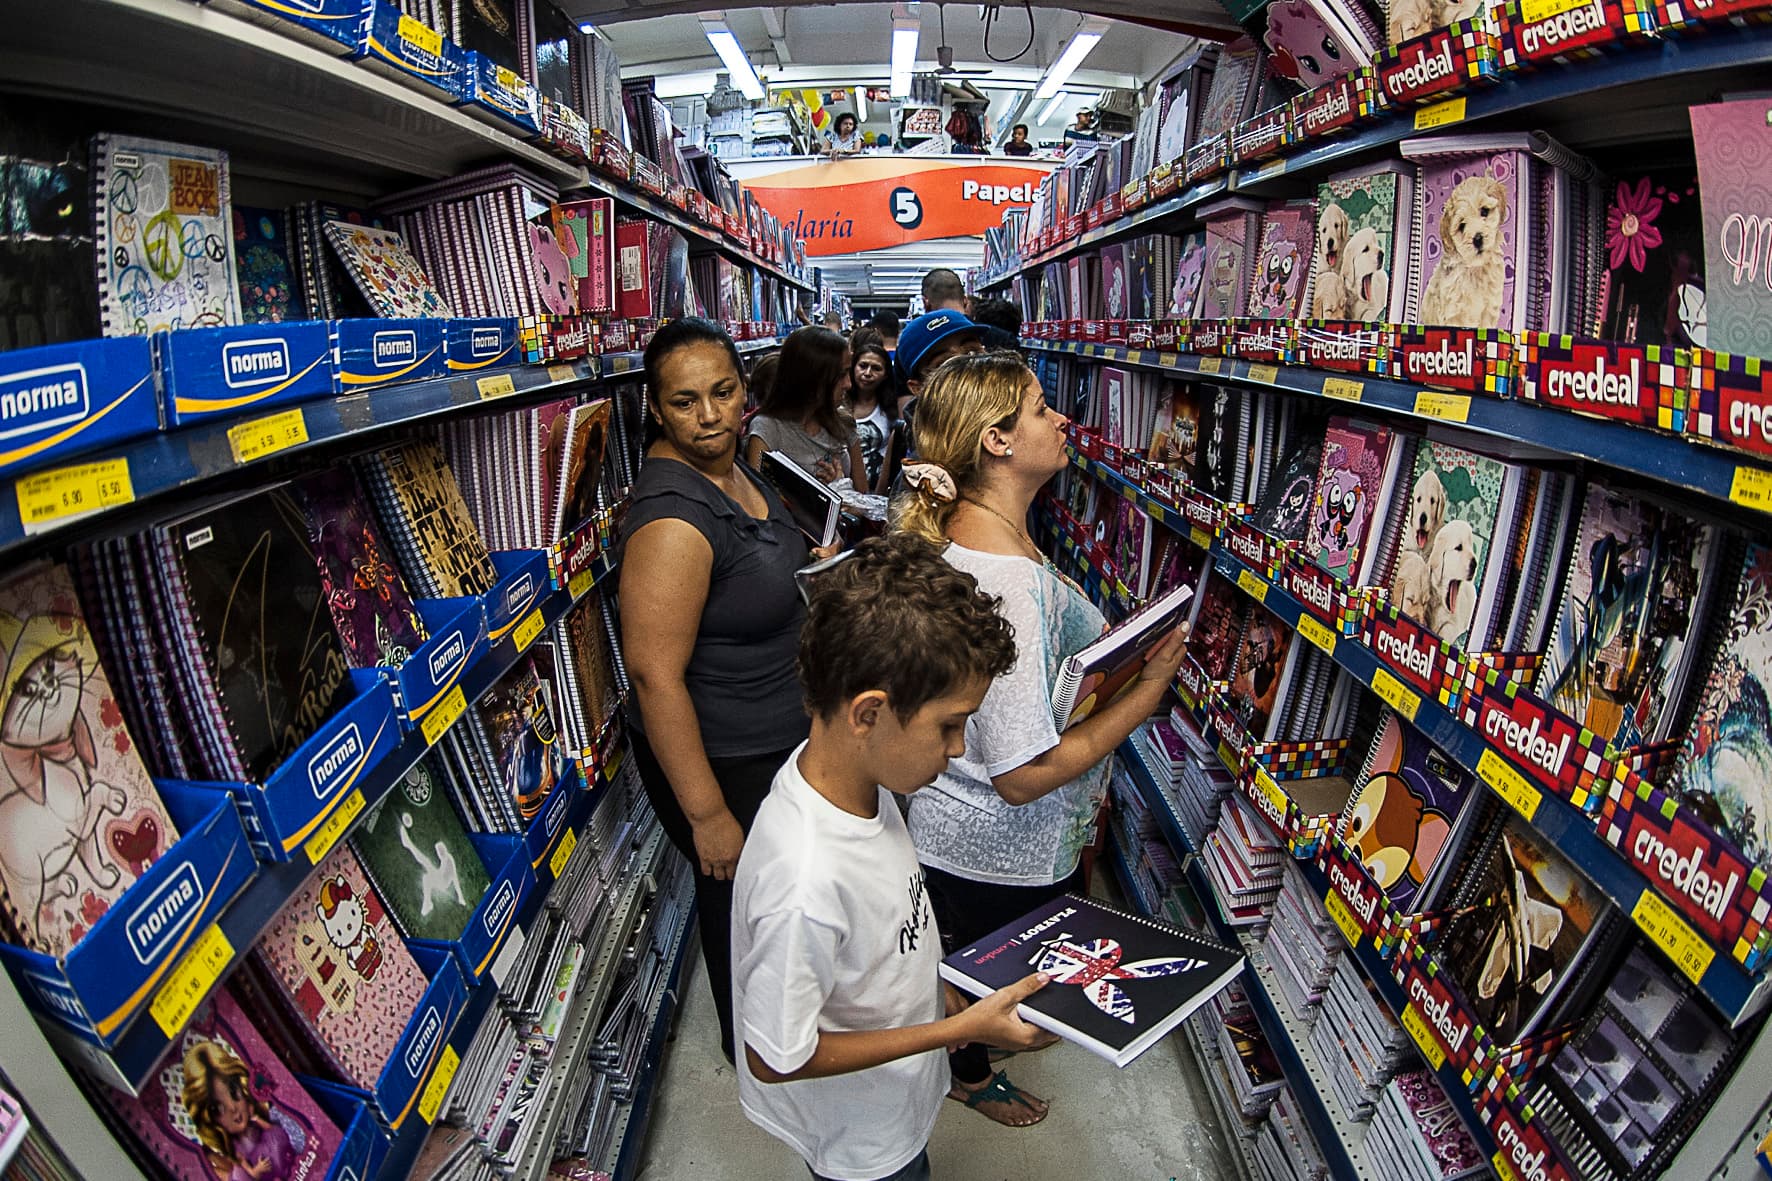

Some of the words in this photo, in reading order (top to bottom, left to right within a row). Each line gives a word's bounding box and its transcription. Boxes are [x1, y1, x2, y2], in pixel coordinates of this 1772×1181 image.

[1522, 0, 1606, 52] credeal
[1388, 40, 1454, 95] credeal
[1306, 83, 1350, 129] credeal
[174, 164, 216, 189] JEAN
[174, 187, 216, 207] BOOK
[895, 192, 919, 224] 5
[378, 338, 412, 356] norma
[475, 335, 499, 349] norma
[1195, 325, 1218, 348] credeal
[1239, 325, 1275, 352] credeal
[1311, 330, 1362, 361] credeal
[230, 350, 283, 374] norma
[1408, 338, 1472, 377] credeal
[0, 379, 78, 420] norma
[1547, 356, 1640, 407] credeal
[189, 530, 211, 546] norma
[570, 527, 595, 572] credeal
[1232, 533, 1264, 563] credeal
[509, 580, 531, 604] norma
[1292, 575, 1332, 612] credeal
[433, 641, 461, 674] norma
[1377, 630, 1436, 680] credeal
[1215, 714, 1244, 752] credeal
[1485, 707, 1571, 778] credeal
[315, 737, 357, 784] norma
[1330, 864, 1378, 925] credeal
[1634, 828, 1740, 923] credeal
[137, 877, 194, 946] norma
[488, 888, 511, 928] norma
[1018, 906, 1078, 942] PLAYBOY
[1410, 977, 1469, 1053] credeal
[410, 1018, 437, 1067] norma
